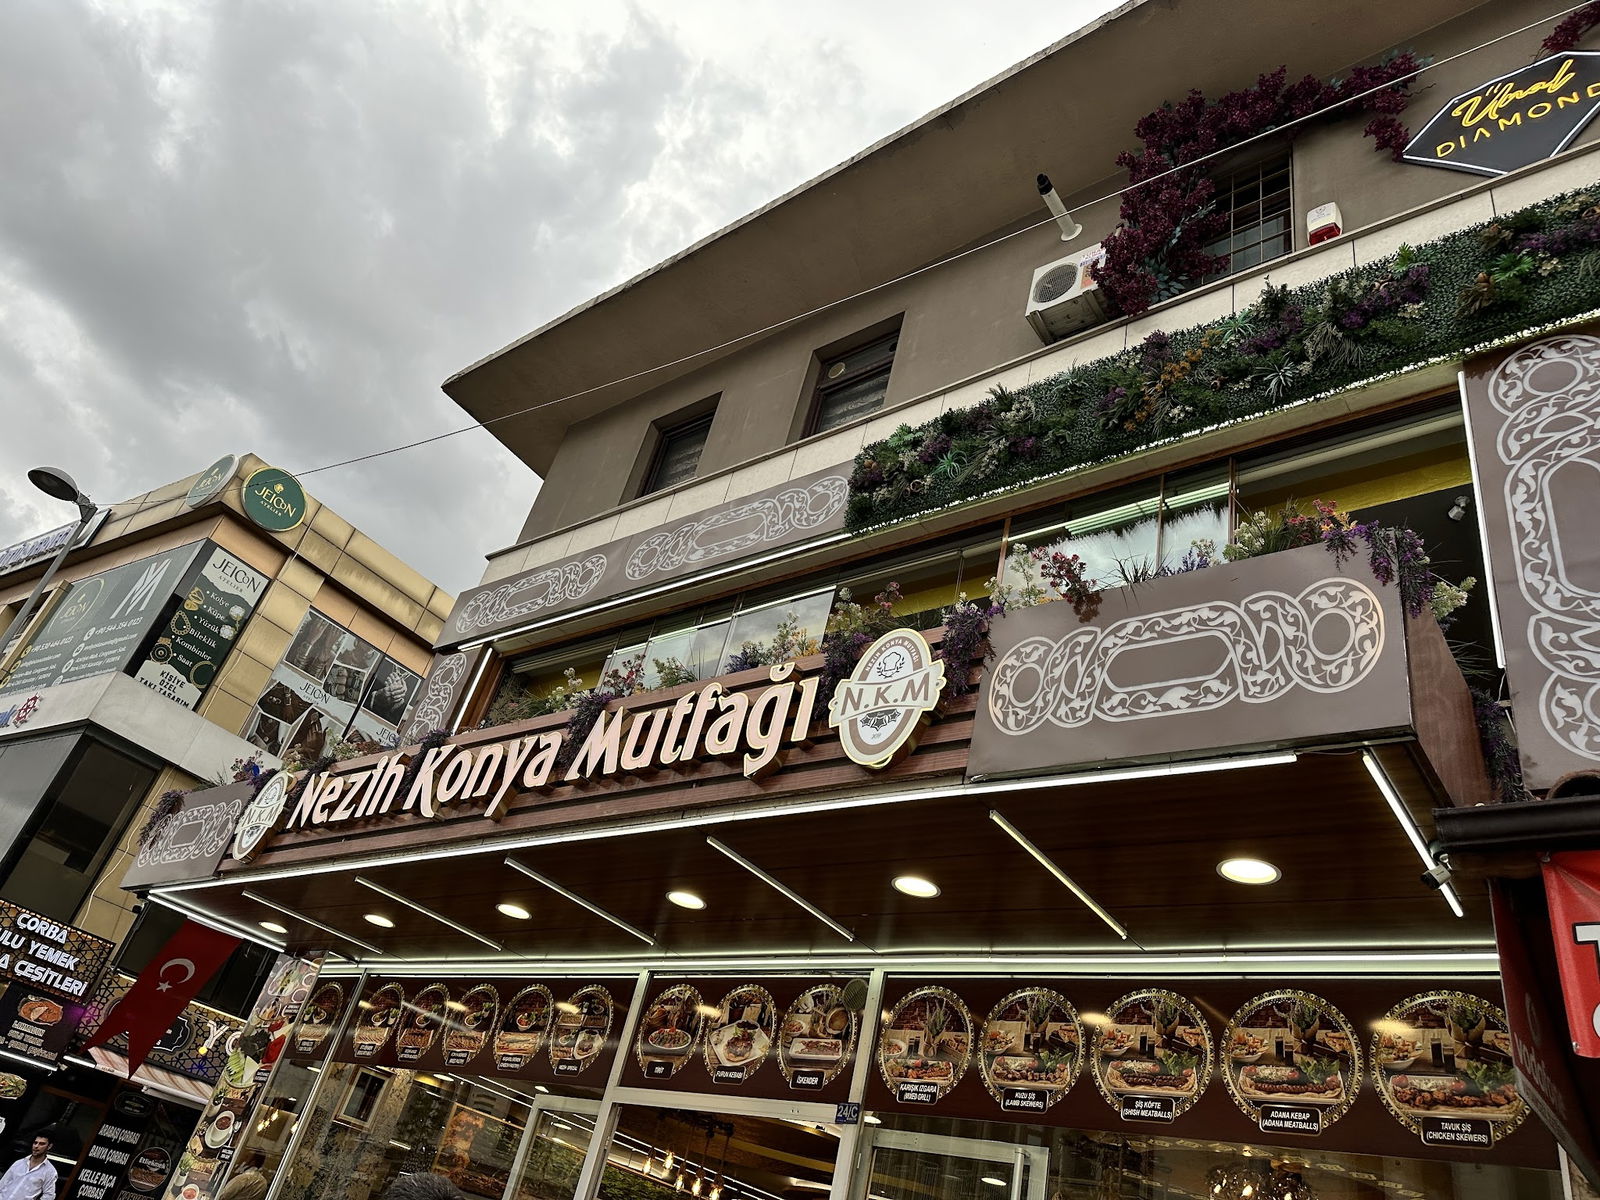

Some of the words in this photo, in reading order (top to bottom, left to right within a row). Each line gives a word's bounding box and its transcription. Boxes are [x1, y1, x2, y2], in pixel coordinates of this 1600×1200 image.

[1436, 82, 1600, 157] DIAMOND
[260, 500, 282, 517] ATELIER
[210, 591, 230, 608] Kolye
[207, 606, 225, 622] Küpe
[199, 616, 220, 634] Yüzük
[189, 627, 217, 649] Bileklik
[881, 639, 903, 652] KONYA
[175, 635, 212, 661] Kombinler
[177, 654, 193, 668] Saat
[840, 670, 931, 717] N.K.M
[286, 752, 405, 829] Nezih
[403, 730, 563, 819] Konya
[564, 661, 820, 782] Mutfağı
[16, 913, 68, 944] ÇORBA
[28, 940, 80, 971] YEMEK
[14, 960, 89, 997] ÇEŞİTLERİ
[796, 1074, 819, 1086] İSKENDER
[900, 1083, 919, 1093] KARIŞIK
[1015, 1091, 1027, 1099] KUZU
[837, 1104, 859, 1120] 24/C
[1018, 1100, 1044, 1109] SKEWERS)
[1134, 1100, 1144, 1109] ŞİŞ
[1144, 1100, 1162, 1110] KÖFTE
[1122, 1108, 1140, 1118] (SHISH
[1140, 1109, 1173, 1120] MEATBALLS)
[1270, 1111, 1290, 1119] ADANA
[1290, 1112, 1311, 1120] KEBAP
[1262, 1118, 1283, 1128] (ADANA
[1283, 1119, 1319, 1132] MEATBALLS)
[1440, 1122, 1461, 1131] TAVUK
[1461, 1122, 1472, 1132] ŞİŞ
[1426, 1131, 1455, 1141] (CHICKEN
[1455, 1132, 1489, 1144] SKEWERS)
[78, 1168, 103, 1185] KELLE
[98, 1172, 117, 1190] PAÇA
